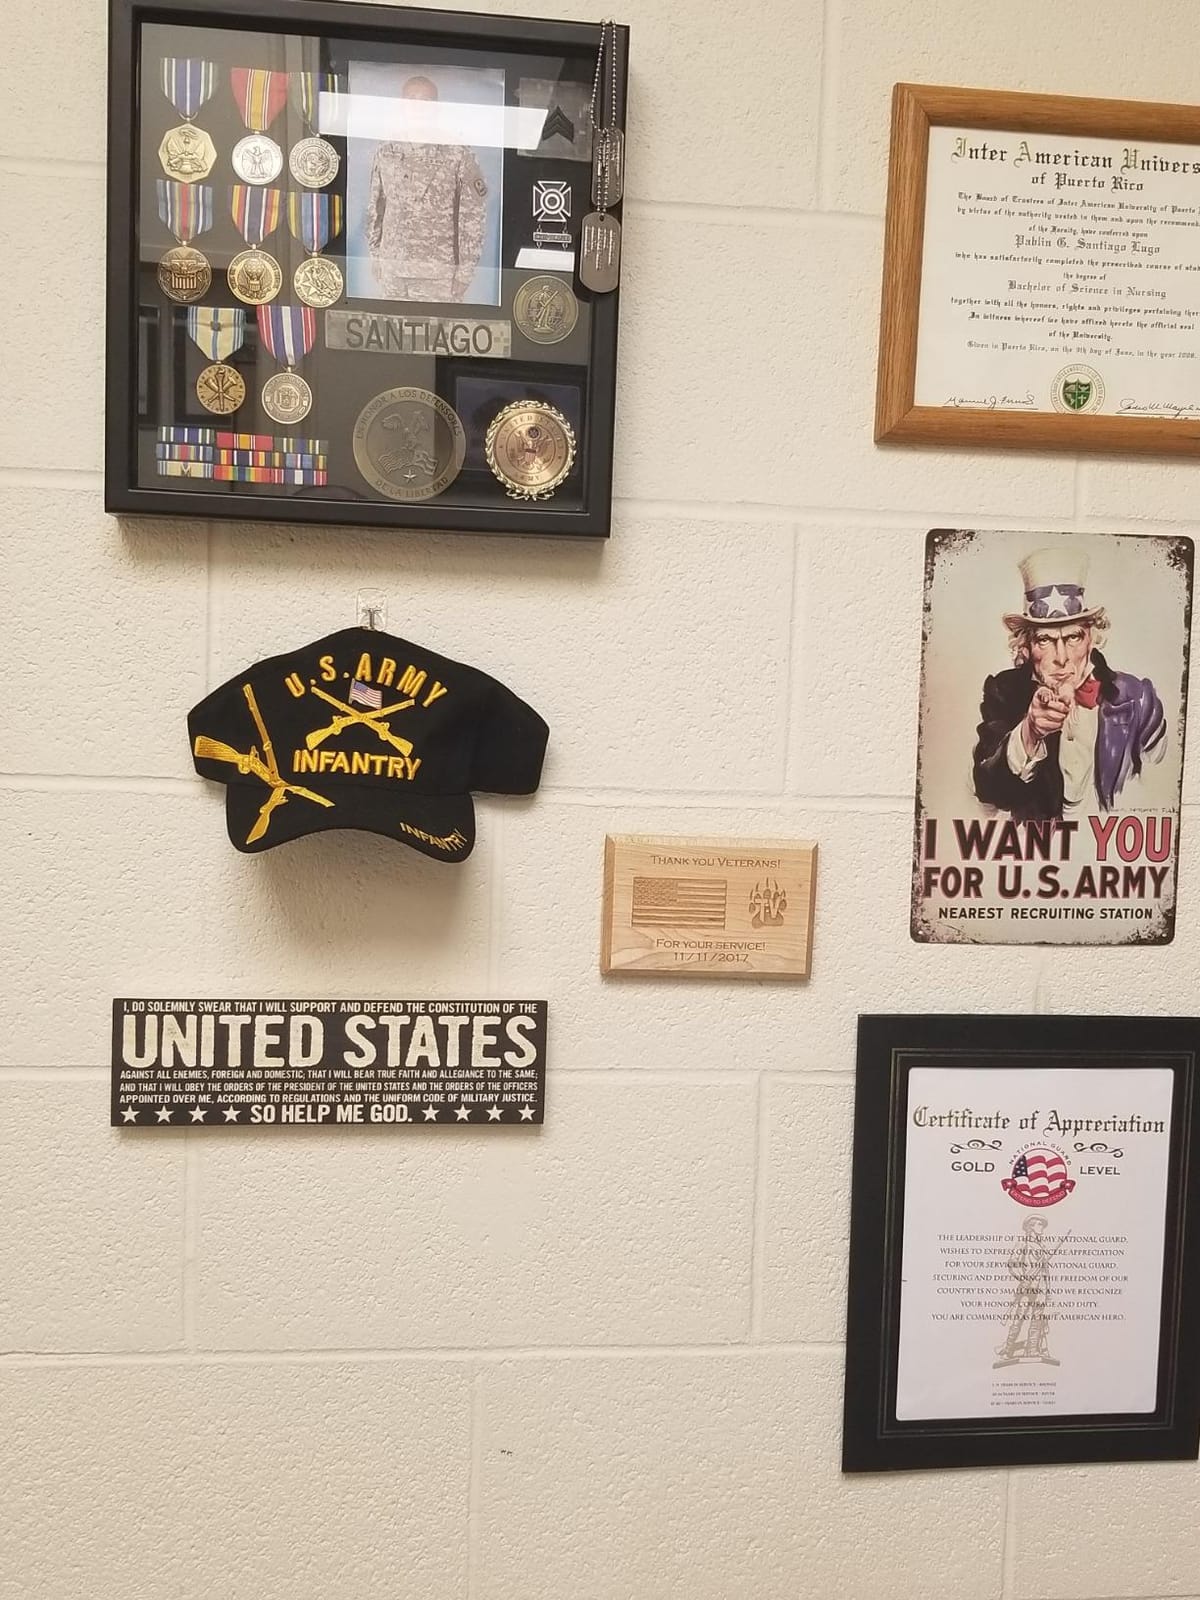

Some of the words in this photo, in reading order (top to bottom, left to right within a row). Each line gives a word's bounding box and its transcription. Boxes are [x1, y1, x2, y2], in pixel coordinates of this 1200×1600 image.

[951, 137, 1008, 164] Inter
[1013, 141, 1112, 168] American
[1032, 172, 1046, 184] of
[1054, 172, 1105, 190] Puerto
[1111, 176, 1144, 194] Rico
[1076, 238, 1126, 254] Santiago
[1131, 241, 1160, 256] Lugo
[1008, 280, 1050, 292] Bachelor
[1056, 283, 1066, 292] of
[1070, 283, 1108, 294] Science
[1113, 287, 1122, 296] in
[1126, 286, 1166, 300] Nursing
[346, 318, 493, 354] SANTIAGO
[293, 749, 422, 781] INFANTRY
[400, 822, 468, 852] INFANTRY
[924, 819, 937, 860] I
[952, 819, 1078, 861] WANT
[1088, 816, 1172, 862] YOU
[922, 866, 984, 899] FOR
[939, 908, 1003, 919] NEAREST
[1010, 908, 1095, 920] RECRUITING
[1100, 908, 1152, 920] STATION
[674, 952, 749, 962] 11/11/2017
[124, 1001, 129, 1012] I,
[132, 1001, 144, 1011] DO
[147, 1001, 195, 1011] SOLEMNLY
[198, 1001, 231, 1012] SWEAR
[234, 1002, 256, 1012] THAT
[260, 1002, 262, 1012] I
[265, 1002, 286, 1012] WILL
[290, 1002, 336, 1012] SUPPORT
[340, 1002, 360, 1012] AND
[364, 1002, 402, 1012] DEFEND
[406, 1002, 425, 1012] THE
[428, 1002, 499, 1013] CONSTITUTION
[502, 1003, 515, 1013] OF
[518, 1003, 537, 1013] THE
[122, 1014, 323, 1068] UNITED
[343, 1014, 536, 1067] STATES
[120, 1070, 154, 1078] AGAINST
[156, 1070, 170, 1078] ALL
[173, 1070, 209, 1079] ENEMIES,
[211, 1070, 244, 1078] FOREIGN
[264, 1070, 304, 1079] DOMESTIC;
[308, 1070, 326, 1078] THAT
[328, 1070, 331, 1078] I
[333, 1070, 351, 1078] WILL
[354, 1069, 374, 1078] BEAR
[377, 1070, 396, 1078] TRUE
[398, 1069, 419, 1078] FAITH
[421, 1070, 437, 1078] AND
[439, 1069, 483, 1078] ALLEGIANCE
[487, 1069, 496, 1078] TO
[498, 1070, 511, 1078] THE
[515, 1070, 537, 1078] SAME;
[119, 1083, 135, 1091] AND
[164, 1083, 182, 1091] WILL
[185, 1082, 204, 1091] OBEY
[207, 1082, 221, 1091] THE
[224, 1082, 253, 1091] ORDERS
[256, 1082, 265, 1090] OF
[268, 1082, 281, 1090] THE
[284, 1082, 324, 1090] PRESIDENT
[327, 1082, 336, 1090] OF
[339, 1082, 353, 1090] THE
[355, 1082, 381, 1090] UNITED
[384, 1082, 409, 1090] STATES
[412, 1082, 426, 1090] AND
[445, 1082, 473, 1090] ORDERS
[476, 1082, 484, 1090] OF
[487, 1082, 500, 1090] THE
[503, 1082, 537, 1090] OFFICERS
[120, 1094, 170, 1103] APPOINTED
[172, 1094, 195, 1102] OVER
[198, 1094, 214, 1103] ME,
[217, 1094, 266, 1102] ACCORDING
[269, 1094, 279, 1102] TO
[282, 1094, 340, 1102] REGULATIONS
[344, 1094, 360, 1102] AND
[364, 1093, 379, 1102] THE
[382, 1093, 420, 1102] UNIFORM
[423, 1093, 444, 1102] CODE
[448, 1093, 458, 1102] OF
[461, 1093, 499, 1102] MILITARY
[502, 1093, 536, 1101] JUSTICE.
[250, 1104, 275, 1122] SO
[281, 1104, 330, 1122] HELP
[336, 1104, 363, 1122] ME
[370, 1104, 412, 1122] GOD.
[913, 1106, 1010, 1130] Certificate
[1019, 1110, 1040, 1130] of
[1043, 1110, 1165, 1137] Appreciation
[951, 1162, 995, 1172] GOLD
[1080, 1166, 1120, 1176] LEVEL
